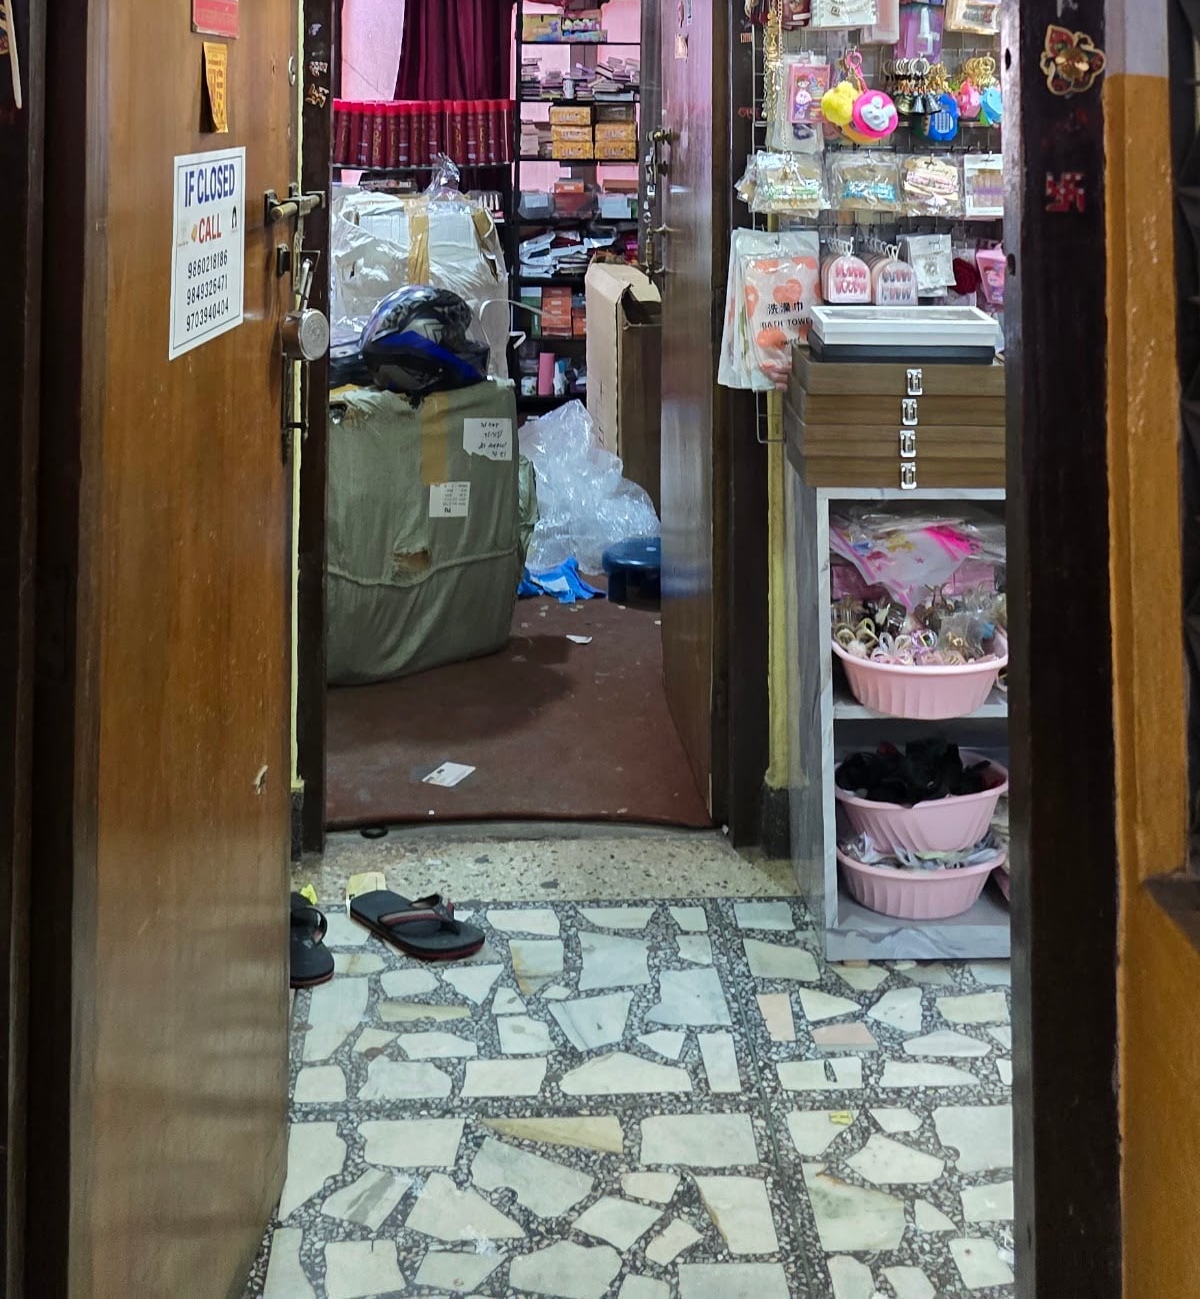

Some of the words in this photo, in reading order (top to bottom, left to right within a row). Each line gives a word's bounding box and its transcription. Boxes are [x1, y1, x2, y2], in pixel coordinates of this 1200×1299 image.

[184, 170, 195, 208] IF
[197, 163, 236, 205] CLOSED
[199, 213, 222, 244] CALL
[187, 249, 228, 280] 9860218186
[186, 273, 228, 306] 9849326471
[186, 296, 229, 332] 9703940404
